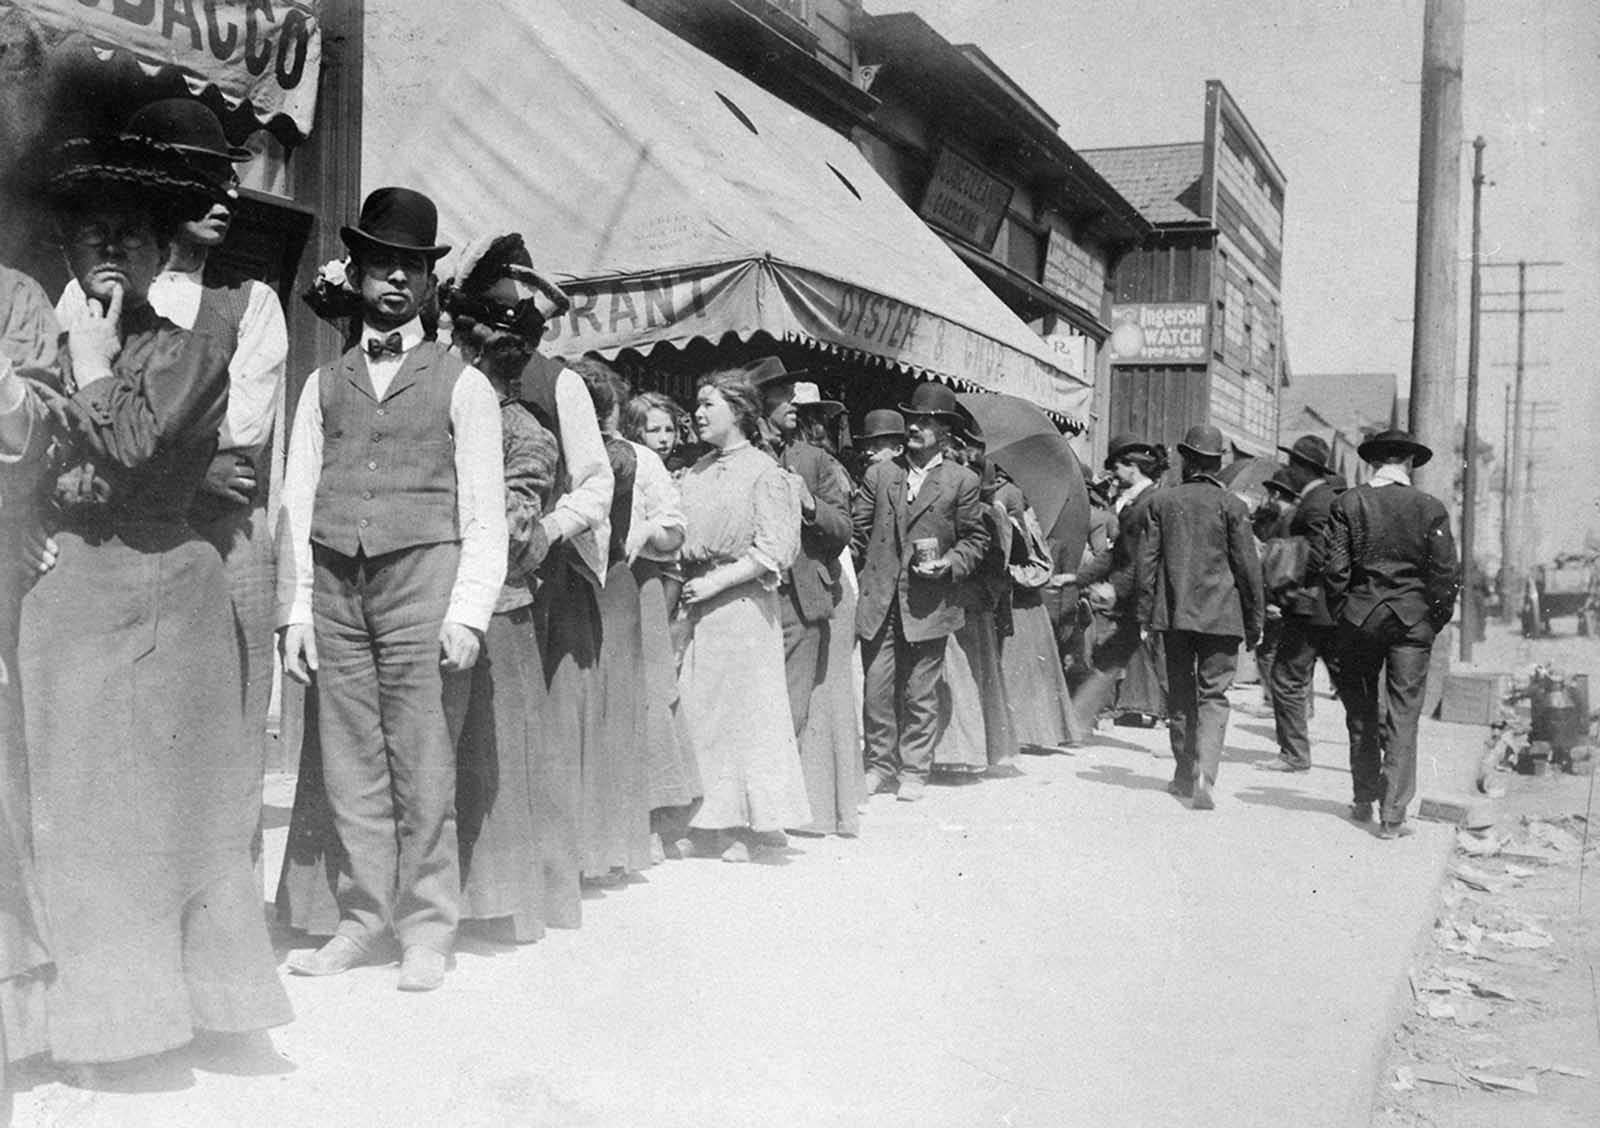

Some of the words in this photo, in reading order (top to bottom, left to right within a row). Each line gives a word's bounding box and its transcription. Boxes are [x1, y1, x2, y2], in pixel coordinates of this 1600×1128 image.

[78, 0, 309, 90] ACCO
[837, 286, 921, 350] OYSTER
[1140, 305, 1206, 328] Ingersoll
[1144, 328, 1203, 345] WATCH
